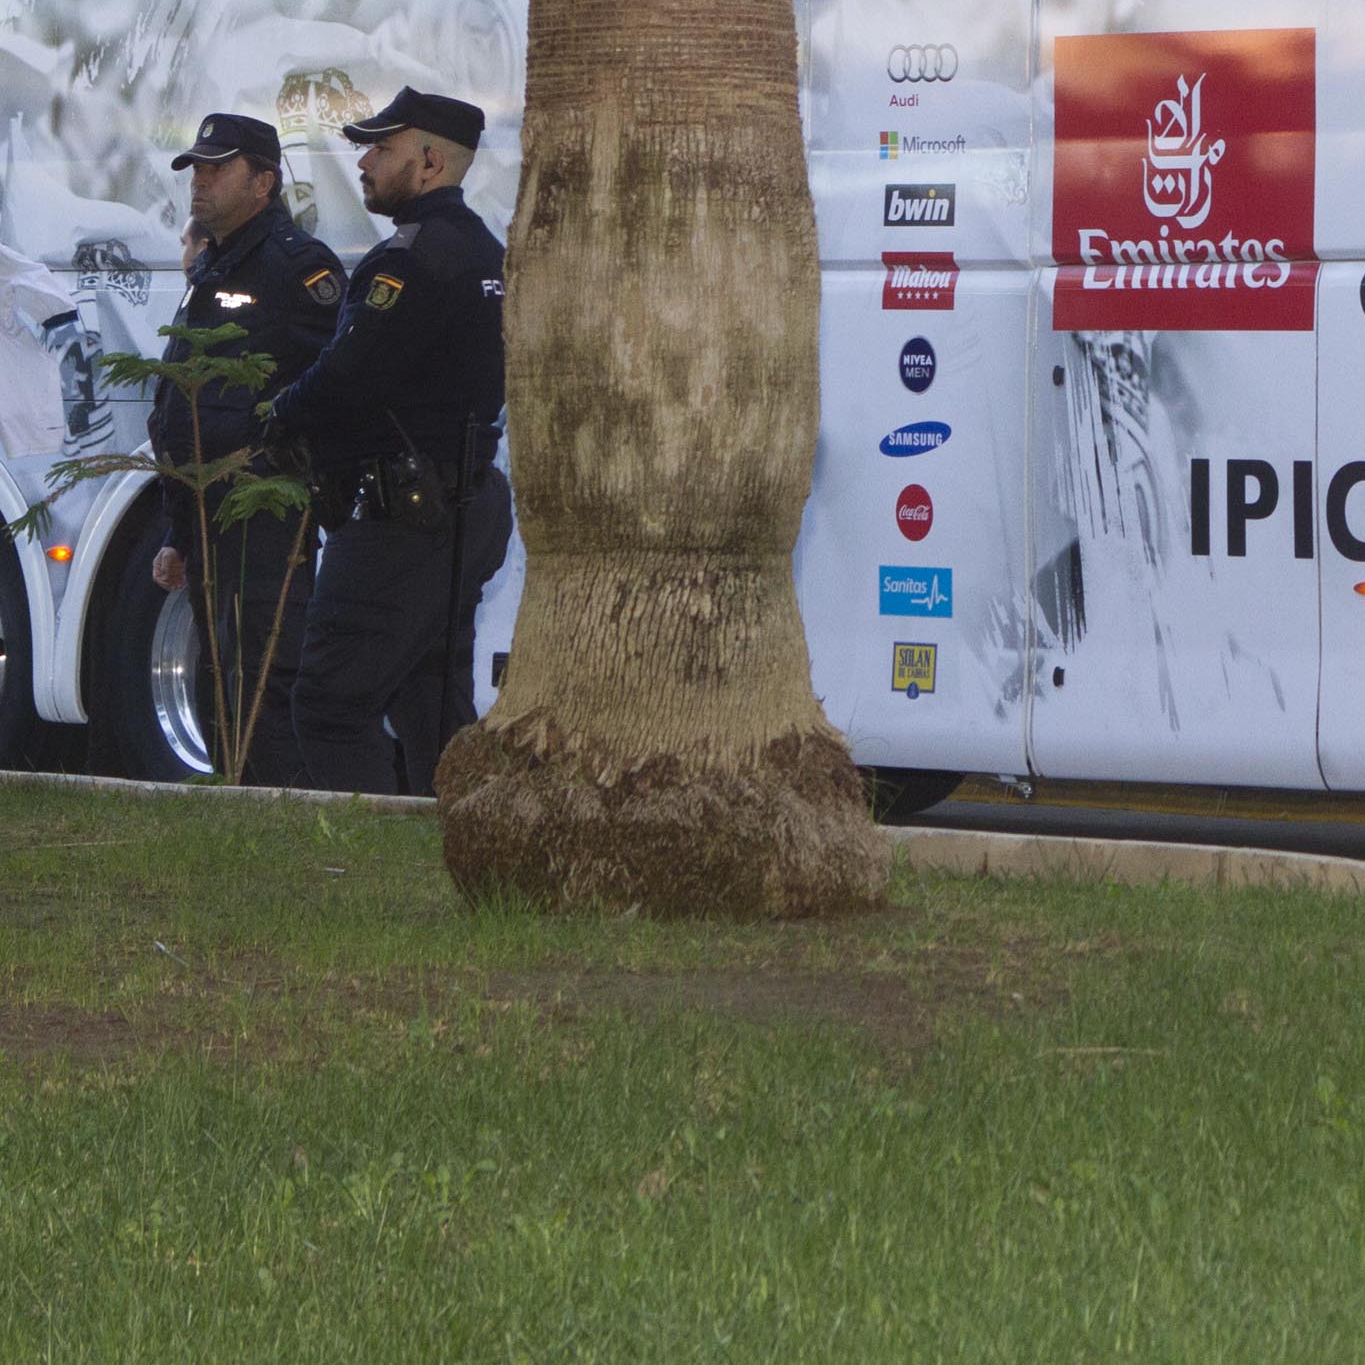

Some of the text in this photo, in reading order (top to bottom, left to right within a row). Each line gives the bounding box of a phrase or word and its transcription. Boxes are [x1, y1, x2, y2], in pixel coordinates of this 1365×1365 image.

[889, 94, 919, 107] Audi
[903, 134, 966, 155] Microsoft
[888, 188, 950, 222] bwin
[1078, 225, 1291, 290] Emirates
[891, 264, 952, 288] Mahou
[903, 354, 933, 366] NIVEA
[905, 367, 930, 378] MEN
[888, 432, 943, 447] SAMSUNG
[883, 576, 928, 594] Sanitas
